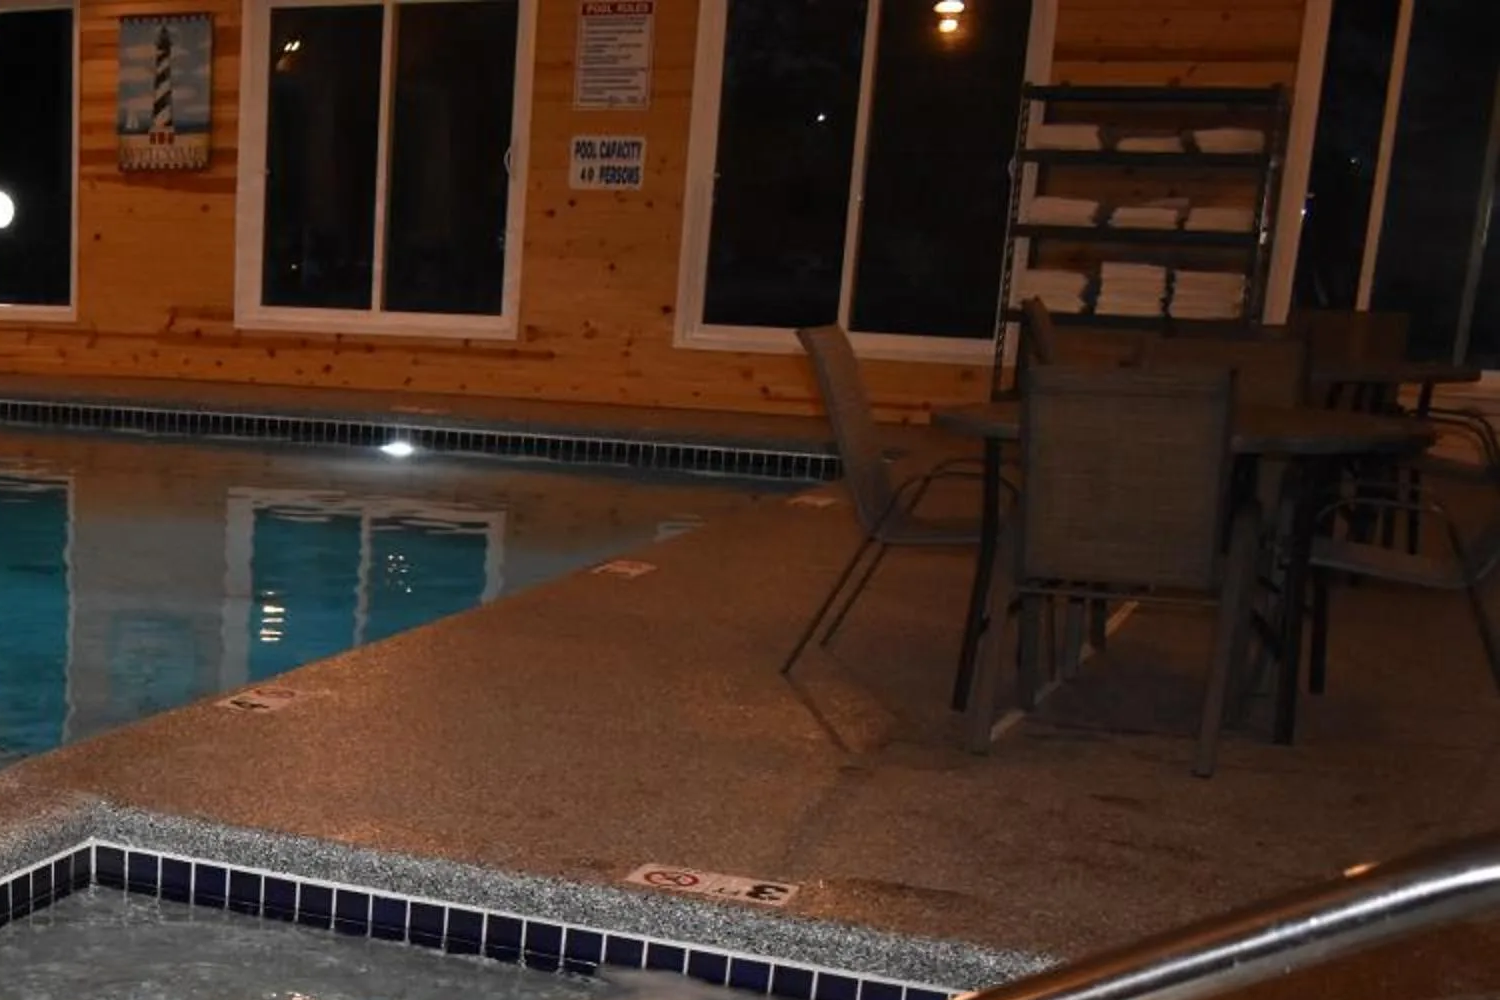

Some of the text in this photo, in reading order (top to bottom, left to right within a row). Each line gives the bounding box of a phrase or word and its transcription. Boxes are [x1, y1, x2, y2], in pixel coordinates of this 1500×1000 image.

[575, 140, 643, 160] POOL CAPACITY
[599, 166, 640, 184] PERSONS
[745, 884, 788, 900] 3
